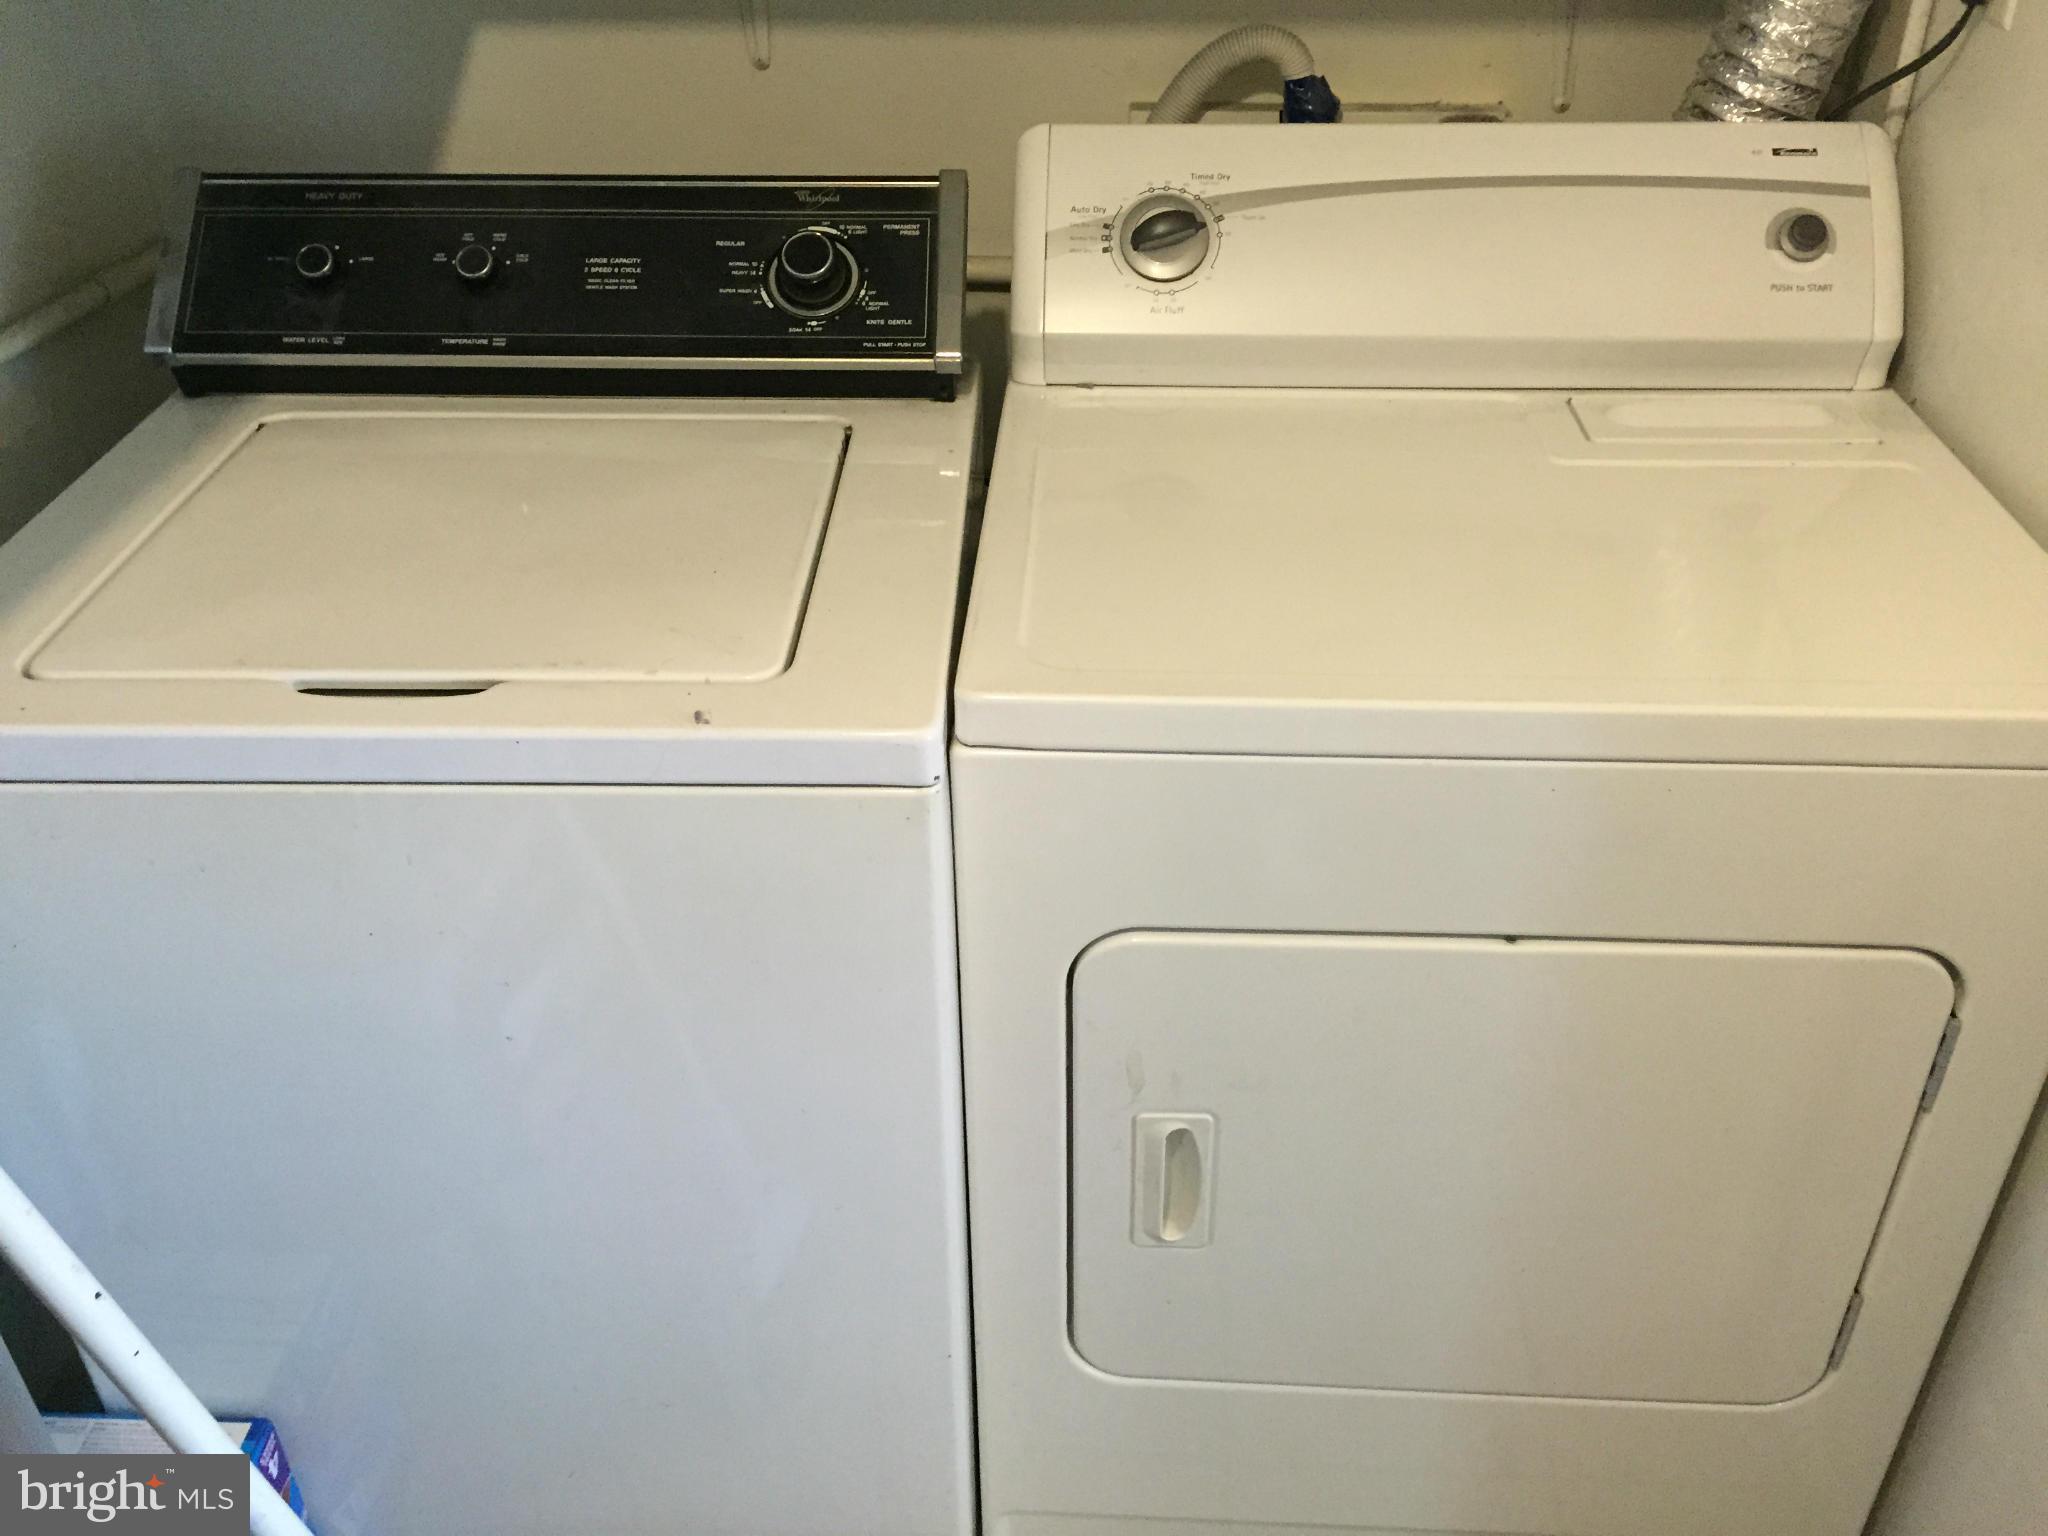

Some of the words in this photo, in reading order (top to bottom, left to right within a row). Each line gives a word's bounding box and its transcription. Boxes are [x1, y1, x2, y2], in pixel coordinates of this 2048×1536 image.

[1217, 173, 1231, 181] Dry
[305, 192, 336, 200] HEAVY
[338, 192, 363, 200] DUTY
[1093, 206, 1107, 214] Dry
[1770, 283, 1793, 292] PUSH
[1796, 283, 1805, 292] to
[1807, 283, 1834, 292] START
[282, 336, 306, 344] WATER
